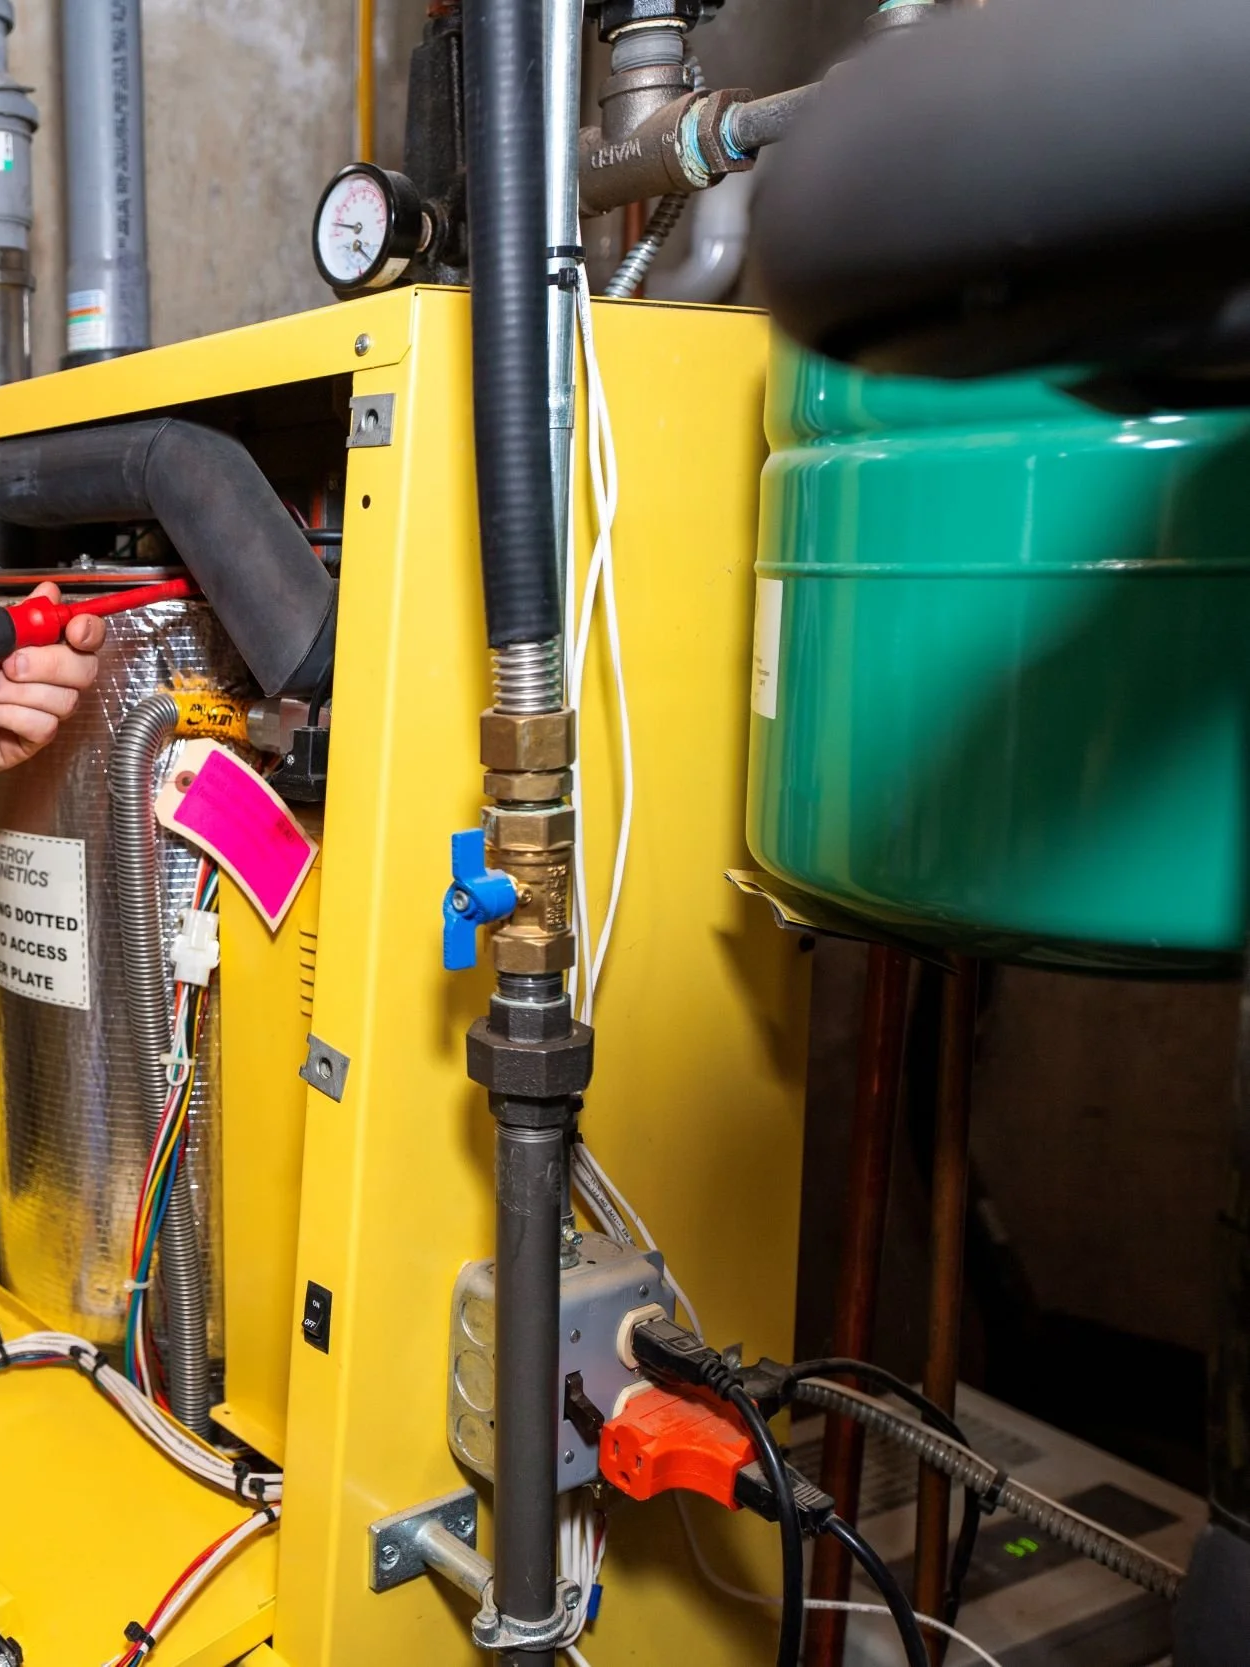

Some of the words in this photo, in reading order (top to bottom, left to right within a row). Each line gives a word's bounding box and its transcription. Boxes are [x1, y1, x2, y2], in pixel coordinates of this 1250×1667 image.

[591, 138, 642, 169] WARD
[15, 907, 78, 931] DOTTED
[10, 936, 68, 962] ACCESS
[11, 966, 54, 991] PLATE
[312, 1299, 320, 1309] ON
[304, 1318, 316, 1328] OFF
